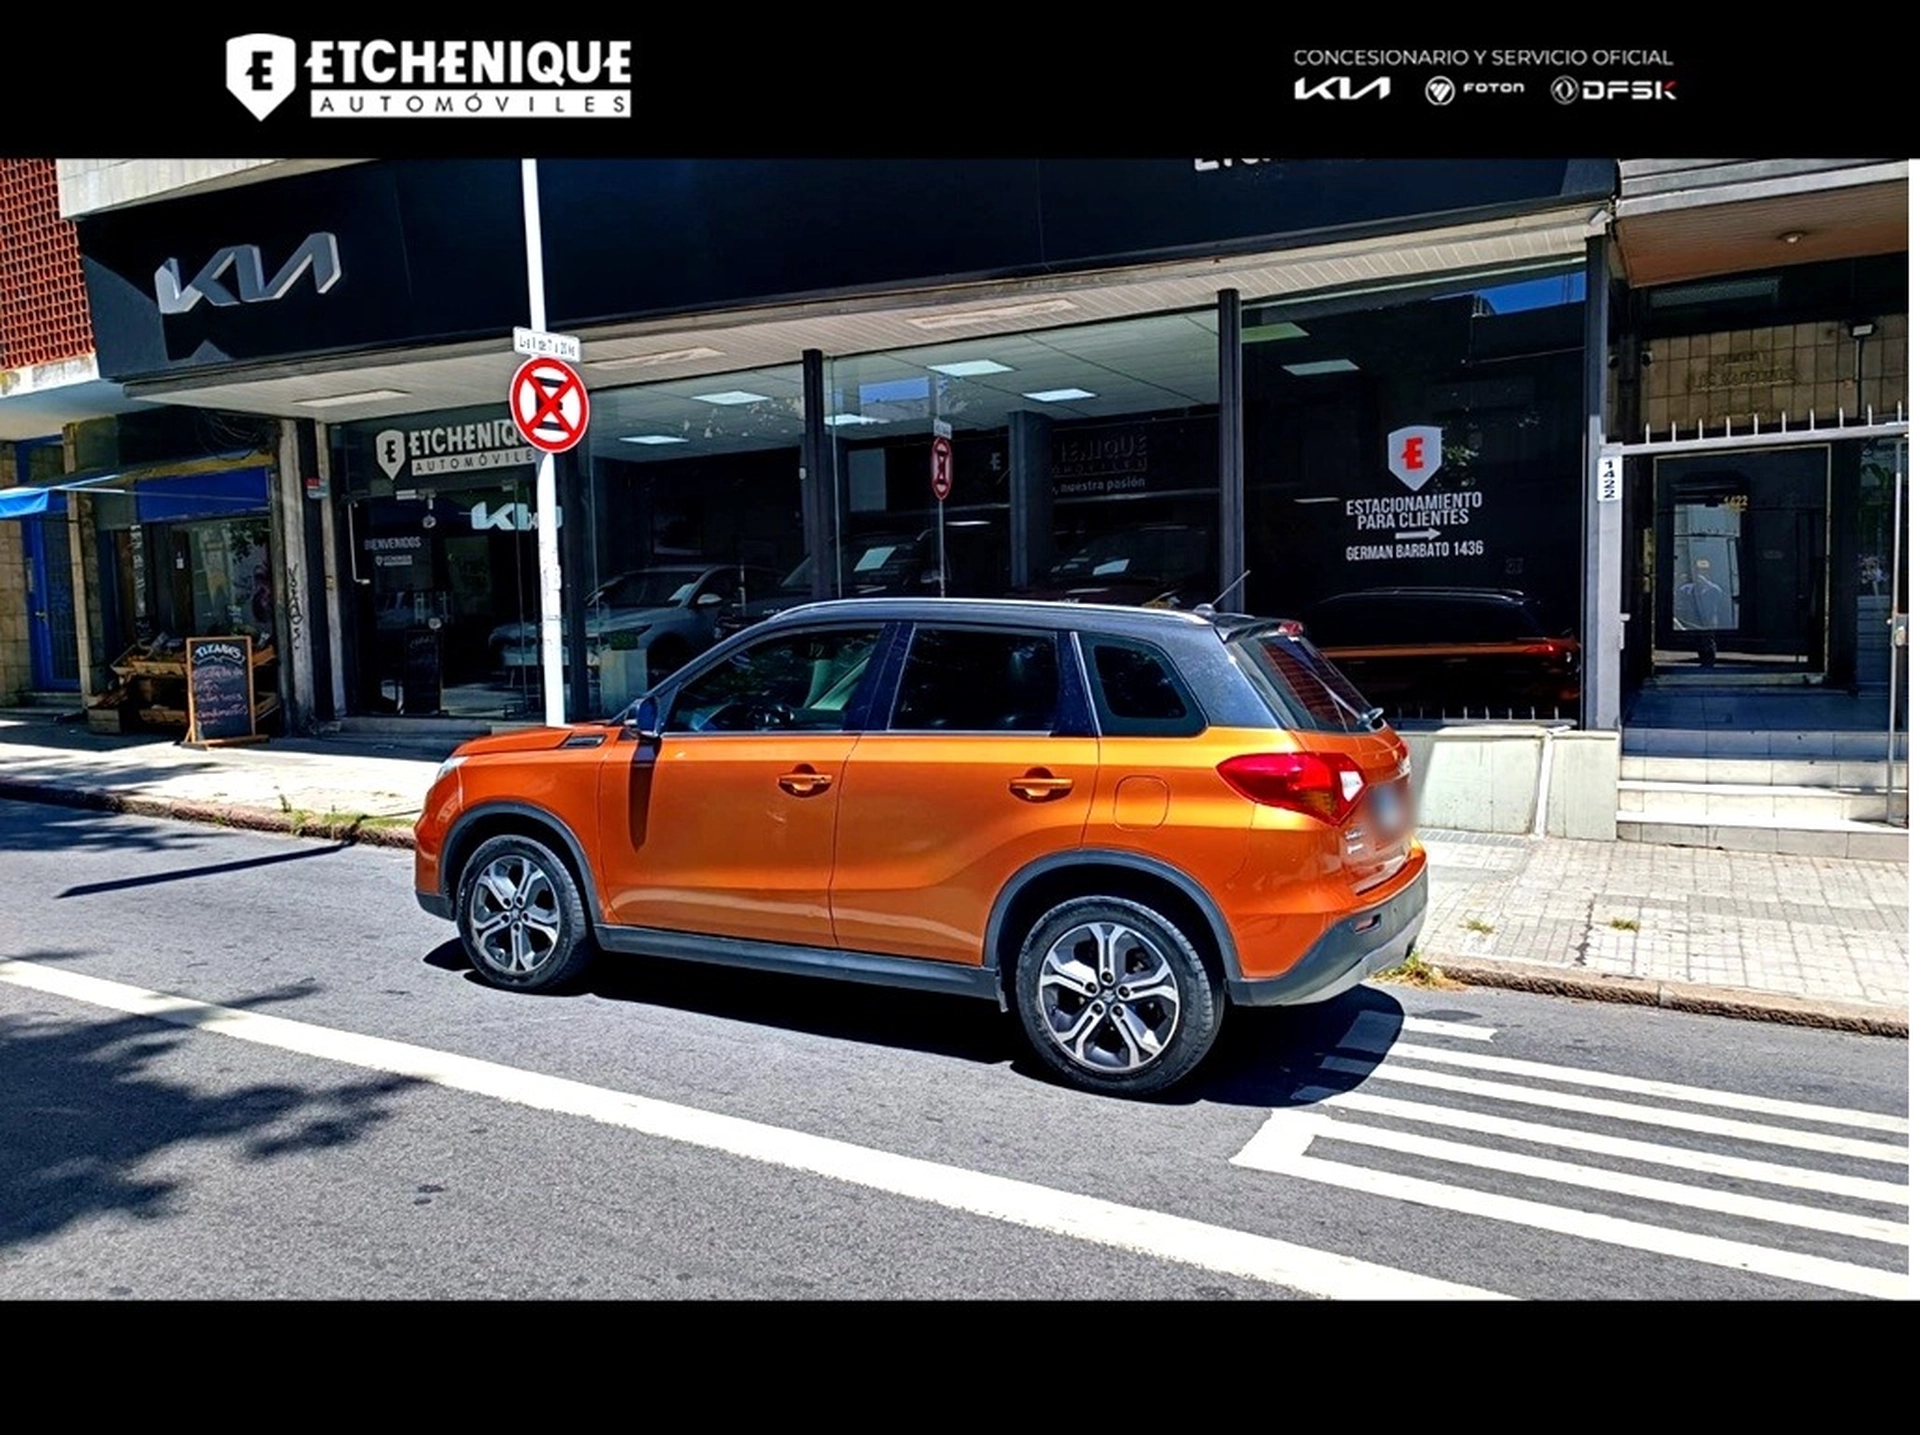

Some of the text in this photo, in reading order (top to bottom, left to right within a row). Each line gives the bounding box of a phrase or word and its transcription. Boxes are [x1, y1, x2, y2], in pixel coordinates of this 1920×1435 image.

[155, 232, 342, 313] KIA
[1107, 477, 1146, 492] pasión
[1345, 491, 1483, 516] ESTACIONAMIENTO
[1357, 508, 1470, 530] PARA CLIENTES
[1345, 539, 1484, 561] GERMAN BARBATO 1436
